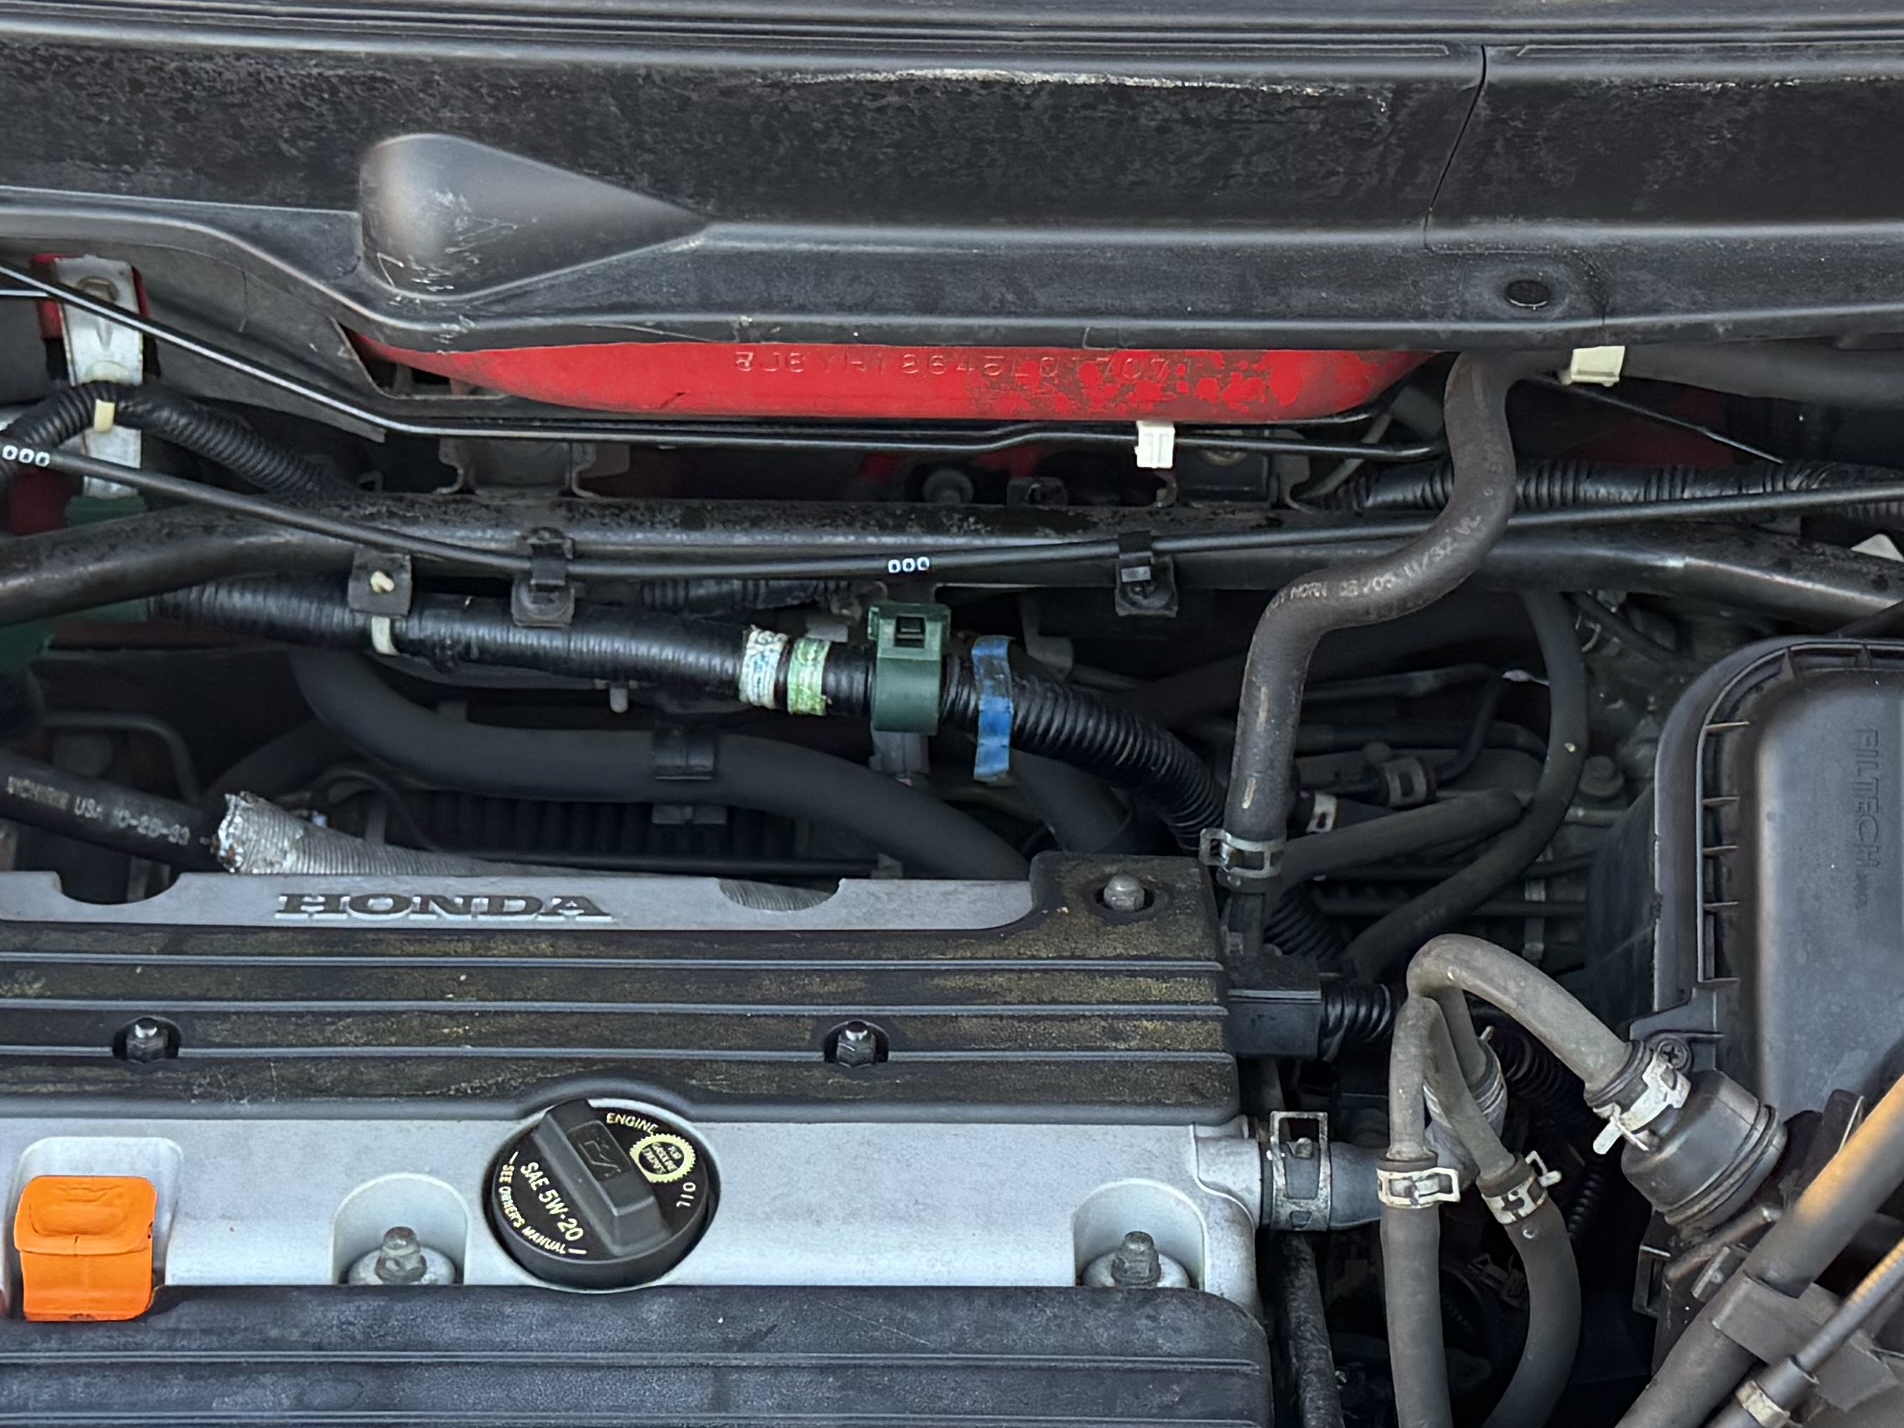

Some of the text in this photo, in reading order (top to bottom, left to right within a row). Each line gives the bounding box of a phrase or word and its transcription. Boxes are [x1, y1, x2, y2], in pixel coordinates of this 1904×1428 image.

[1853, 728, 1881, 868] FILTECH
[275, 892, 614, 922] HONDA
[606, 1112, 658, 1134] ENGINE
[519, 1161, 551, 1191] SAE
[498, 1164, 515, 1184] SEE
[521, 1225, 568, 1255] MANUAL
[676, 1181, 697, 1208] OIL
